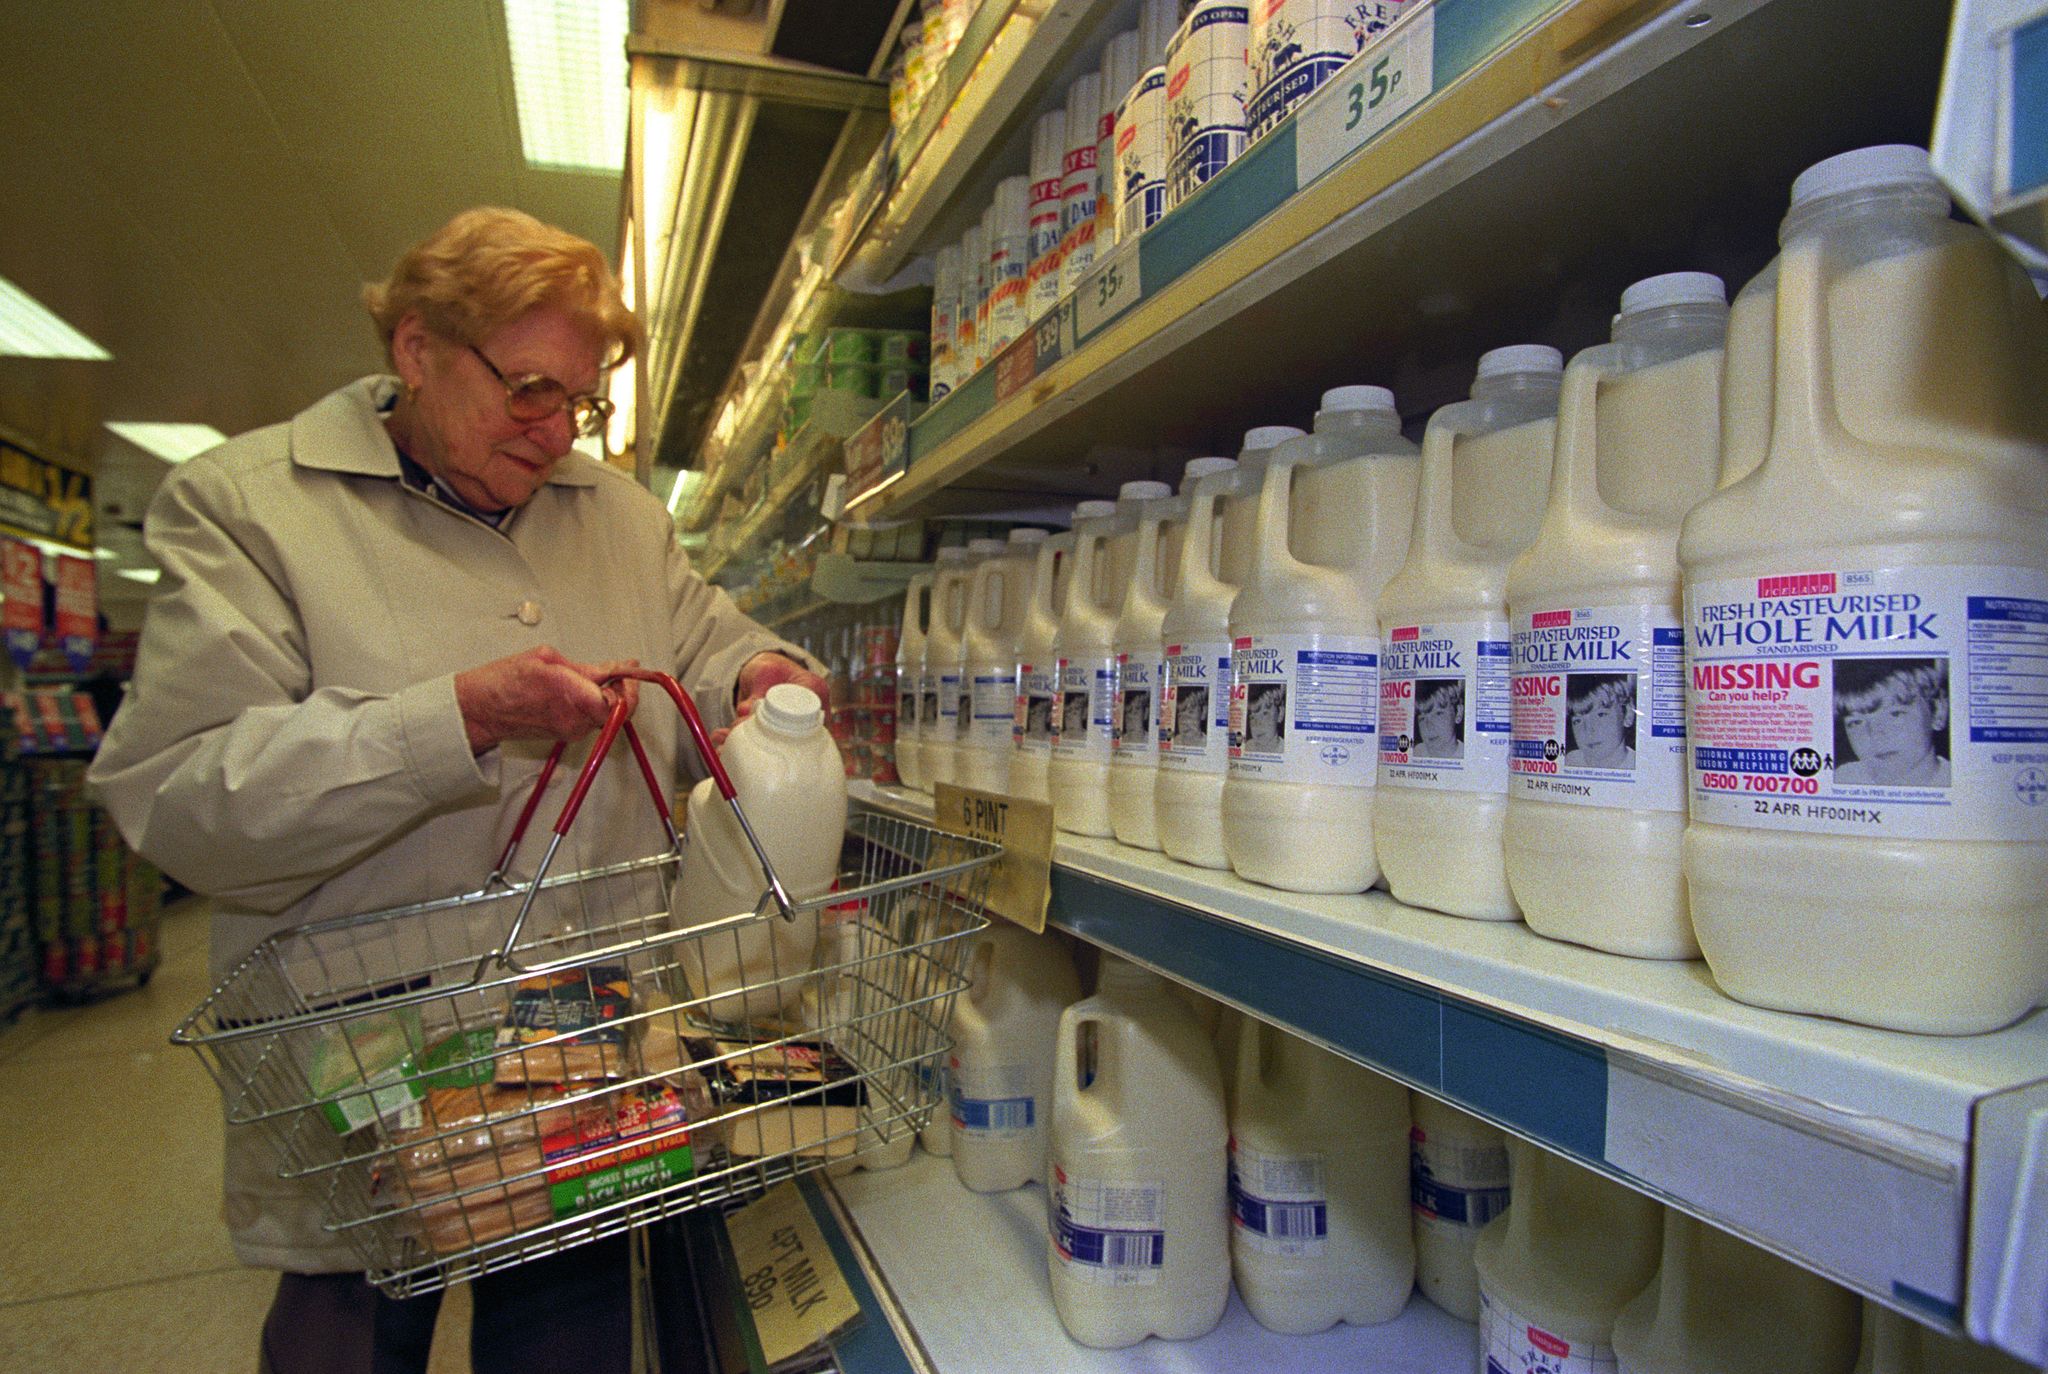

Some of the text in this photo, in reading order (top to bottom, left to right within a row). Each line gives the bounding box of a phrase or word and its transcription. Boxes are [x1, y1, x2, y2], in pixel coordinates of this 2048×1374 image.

[1344, 56, 1402, 131] 35p
[1764, 584, 1830, 597] ICELAND
[1702, 593, 1922, 623] FRESH PASTEURISED
[1533, 625, 1621, 643] PASTEURISED
[1695, 613, 1939, 648] WHOLE MILK
[1512, 639, 1632, 665] HOLE MILK
[1757, 643, 1838, 655] STANDARDISED
[1247, 659, 1284, 674] MILK
[1381, 651, 1461, 672] HOLE MILK
[1693, 661, 1820, 690] MISSING
[1708, 690, 1789, 704] Can you help?
[1738, 751, 1786, 762] MISSING
[1523, 760, 1557, 774] 700700
[1733, 761, 1786, 772] HELPLINE
[1535, 781, 1549, 792] APR
[1703, 772, 1818, 795] 0500 700700
[963, 796, 1009, 834] 6 PINT
[1754, 800, 1769, 813] 22
[1772, 803, 1801, 817] APR
[780, 1258, 829, 1319] MILK
